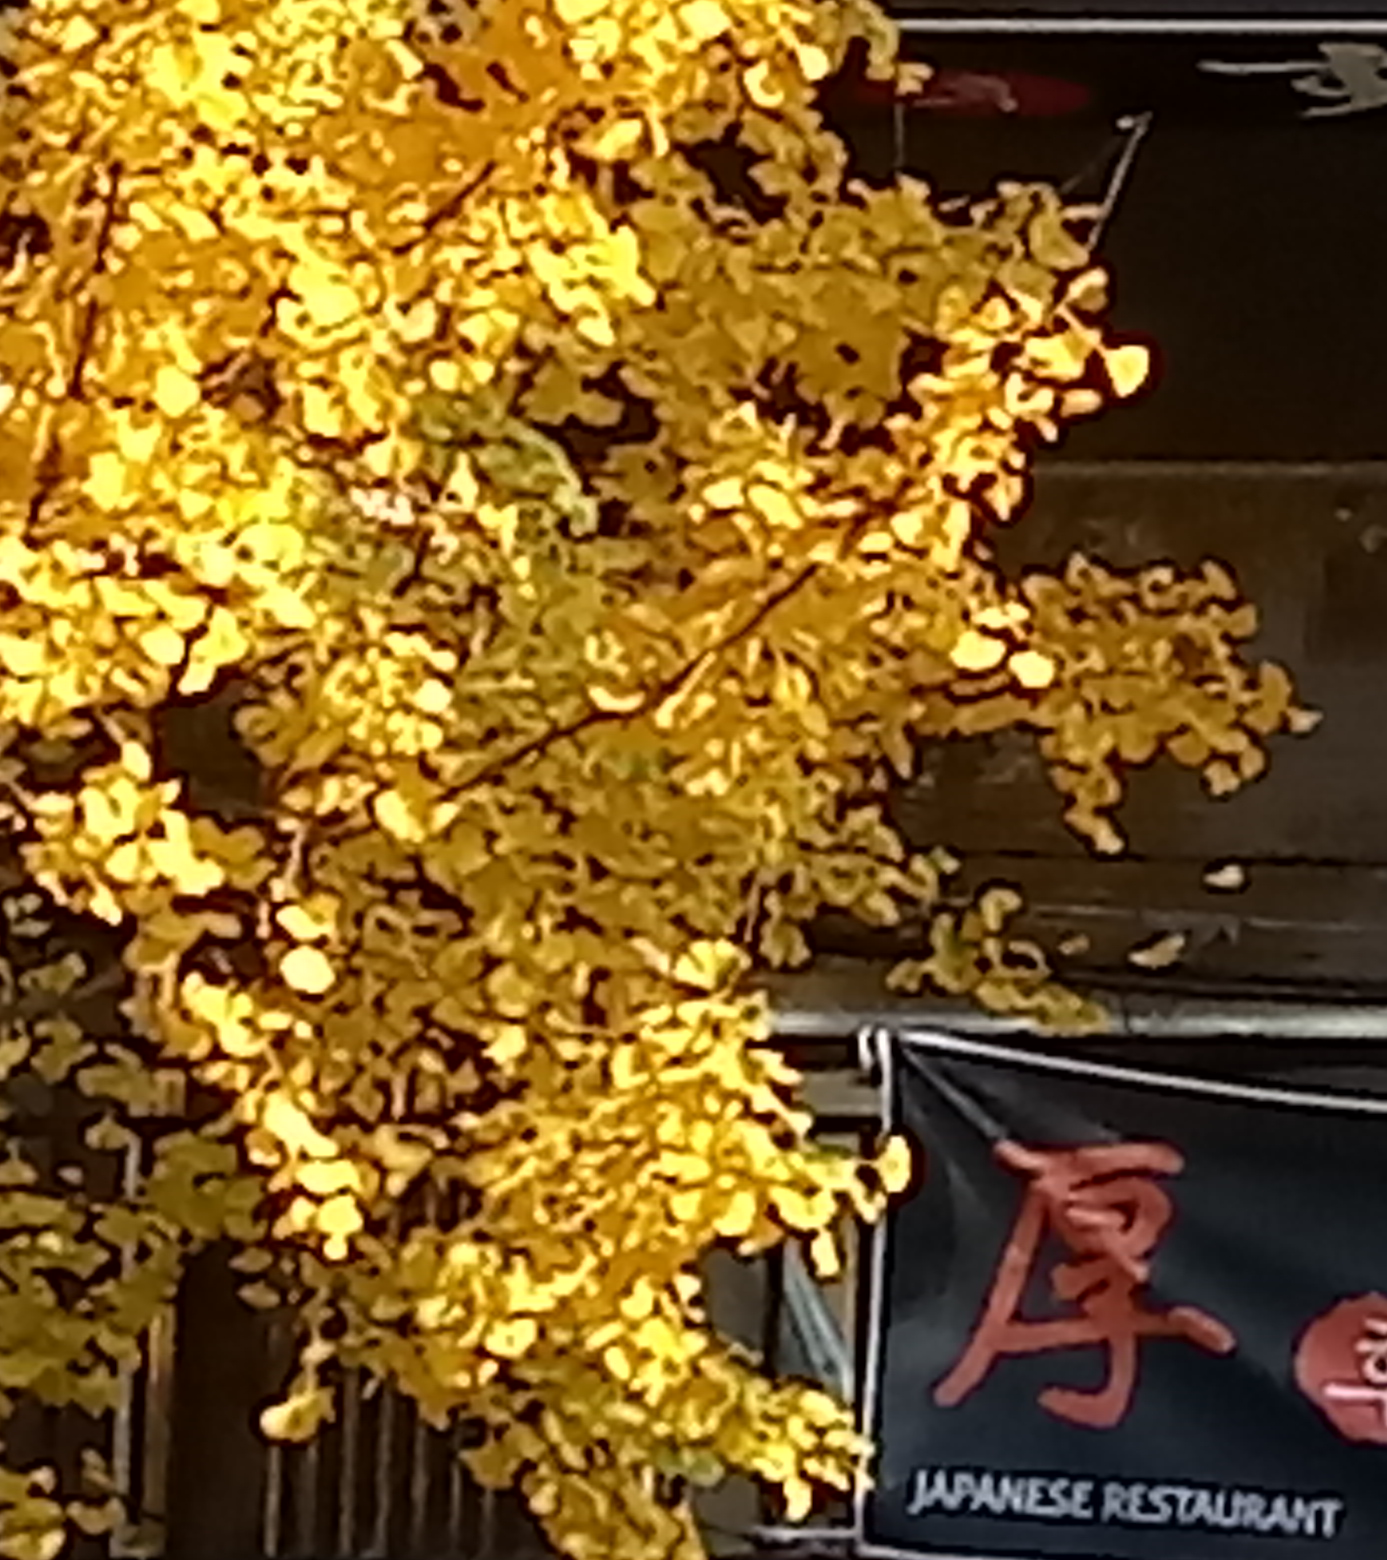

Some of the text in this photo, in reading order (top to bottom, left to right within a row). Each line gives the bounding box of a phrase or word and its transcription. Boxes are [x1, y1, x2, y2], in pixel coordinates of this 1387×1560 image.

[932, 1140, 1236, 1428] 厚
[906, 1469, 1343, 1538] JAPANESE RESTAURANT
